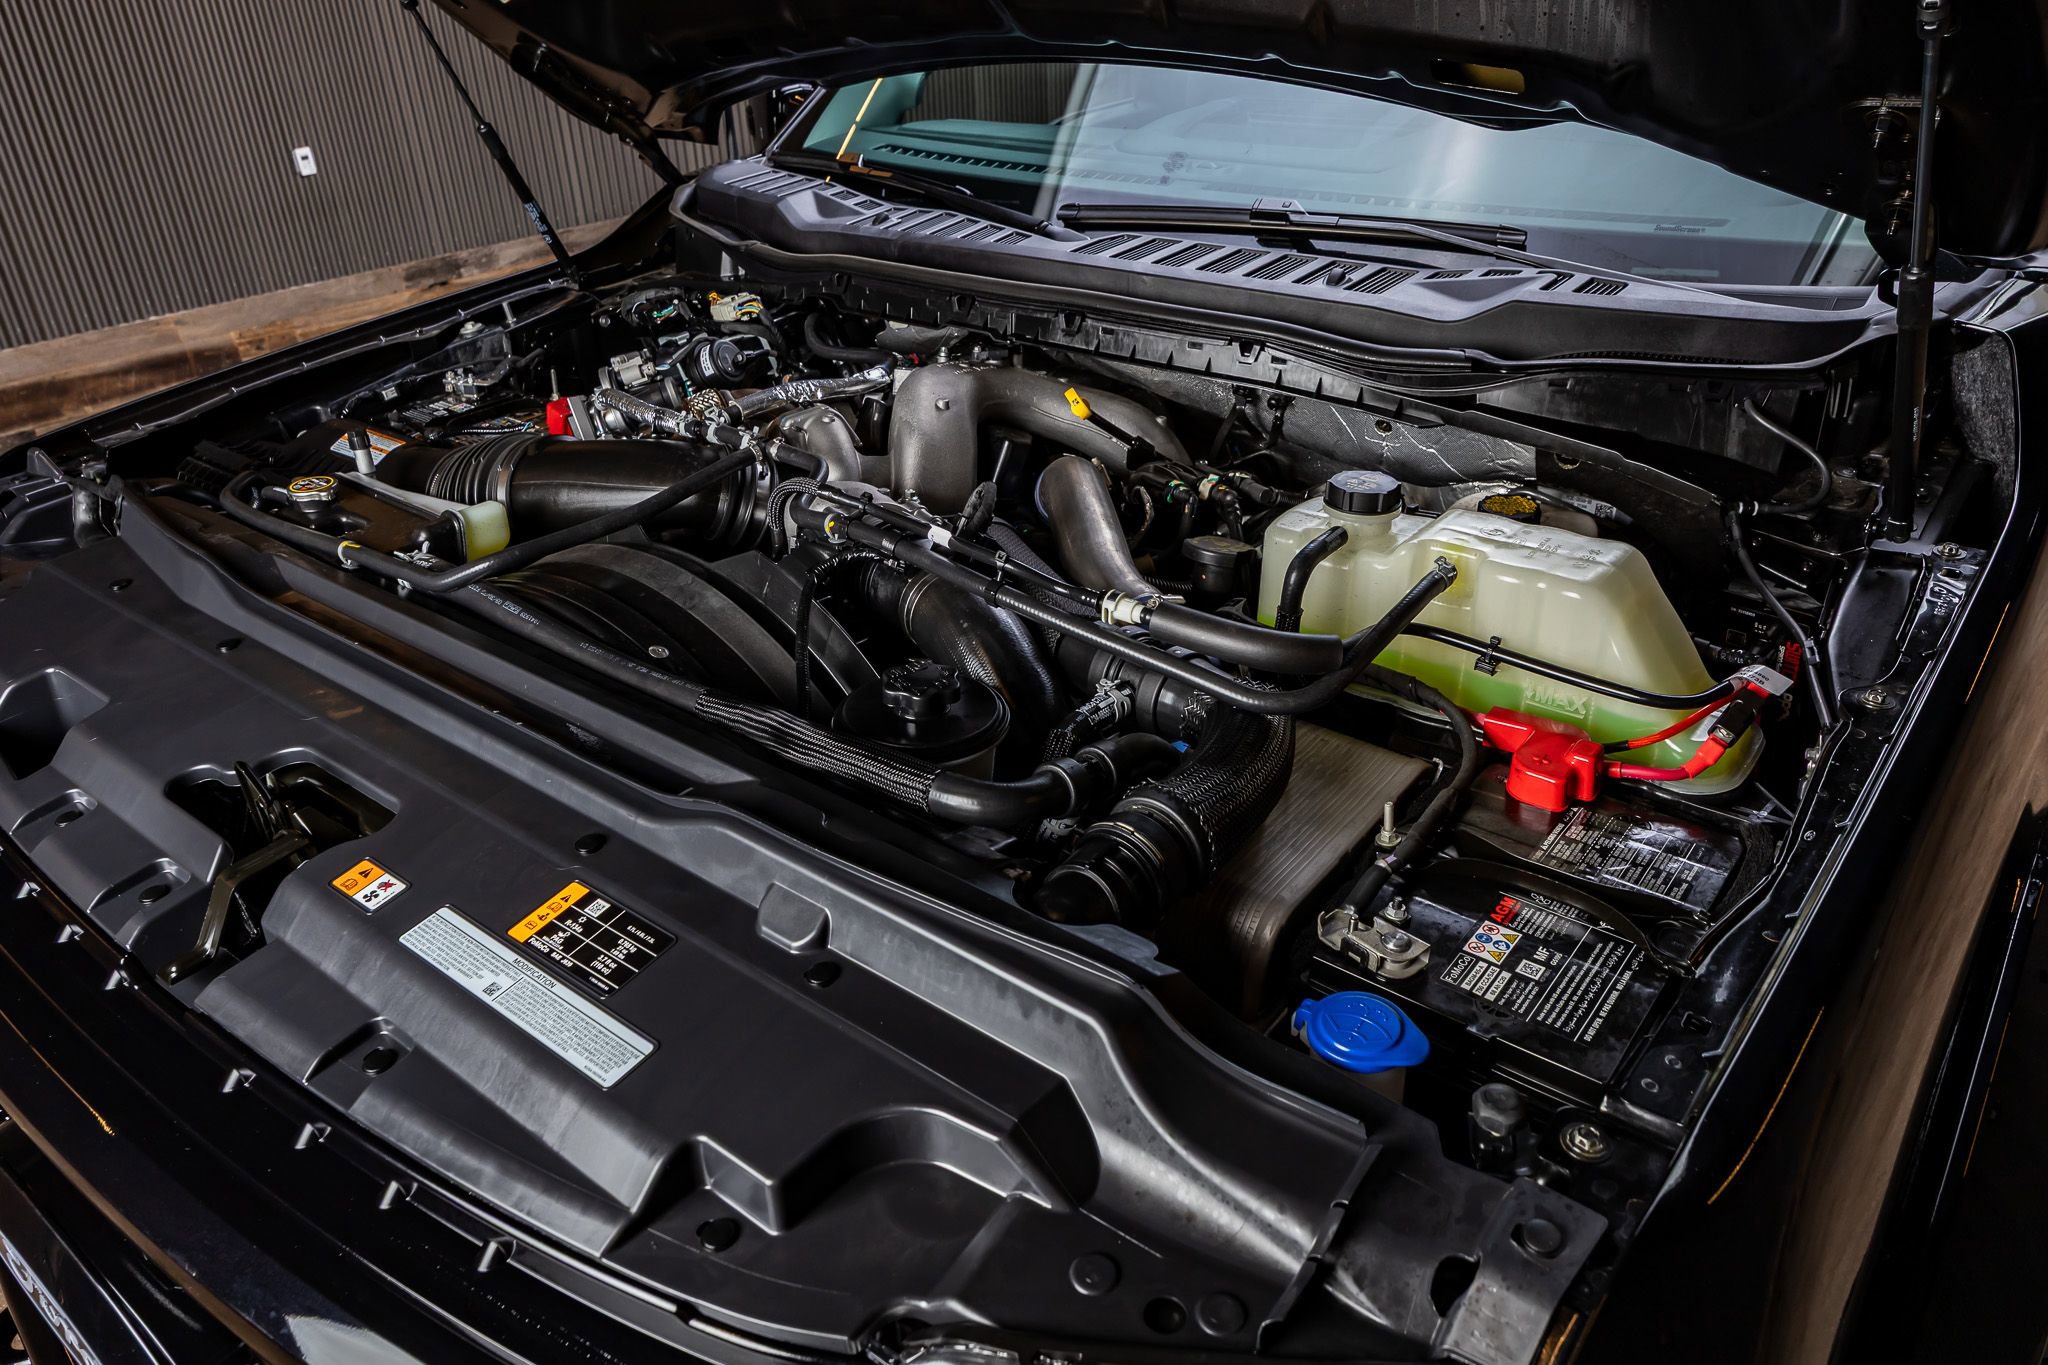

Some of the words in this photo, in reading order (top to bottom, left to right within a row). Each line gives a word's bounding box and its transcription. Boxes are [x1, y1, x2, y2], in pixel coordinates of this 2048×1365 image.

[1534, 686, 1588, 715] MAX
[1491, 896, 1516, 922] AGM
[564, 919, 583, 933] R-134a
[527, 937, 550, 953] FoMoCo
[550, 934, 564, 944] PAG
[1533, 946, 1549, 961] MF
[512, 957, 556, 990] MODIFICATION
[1446, 955, 1471, 982] FoMoCo
